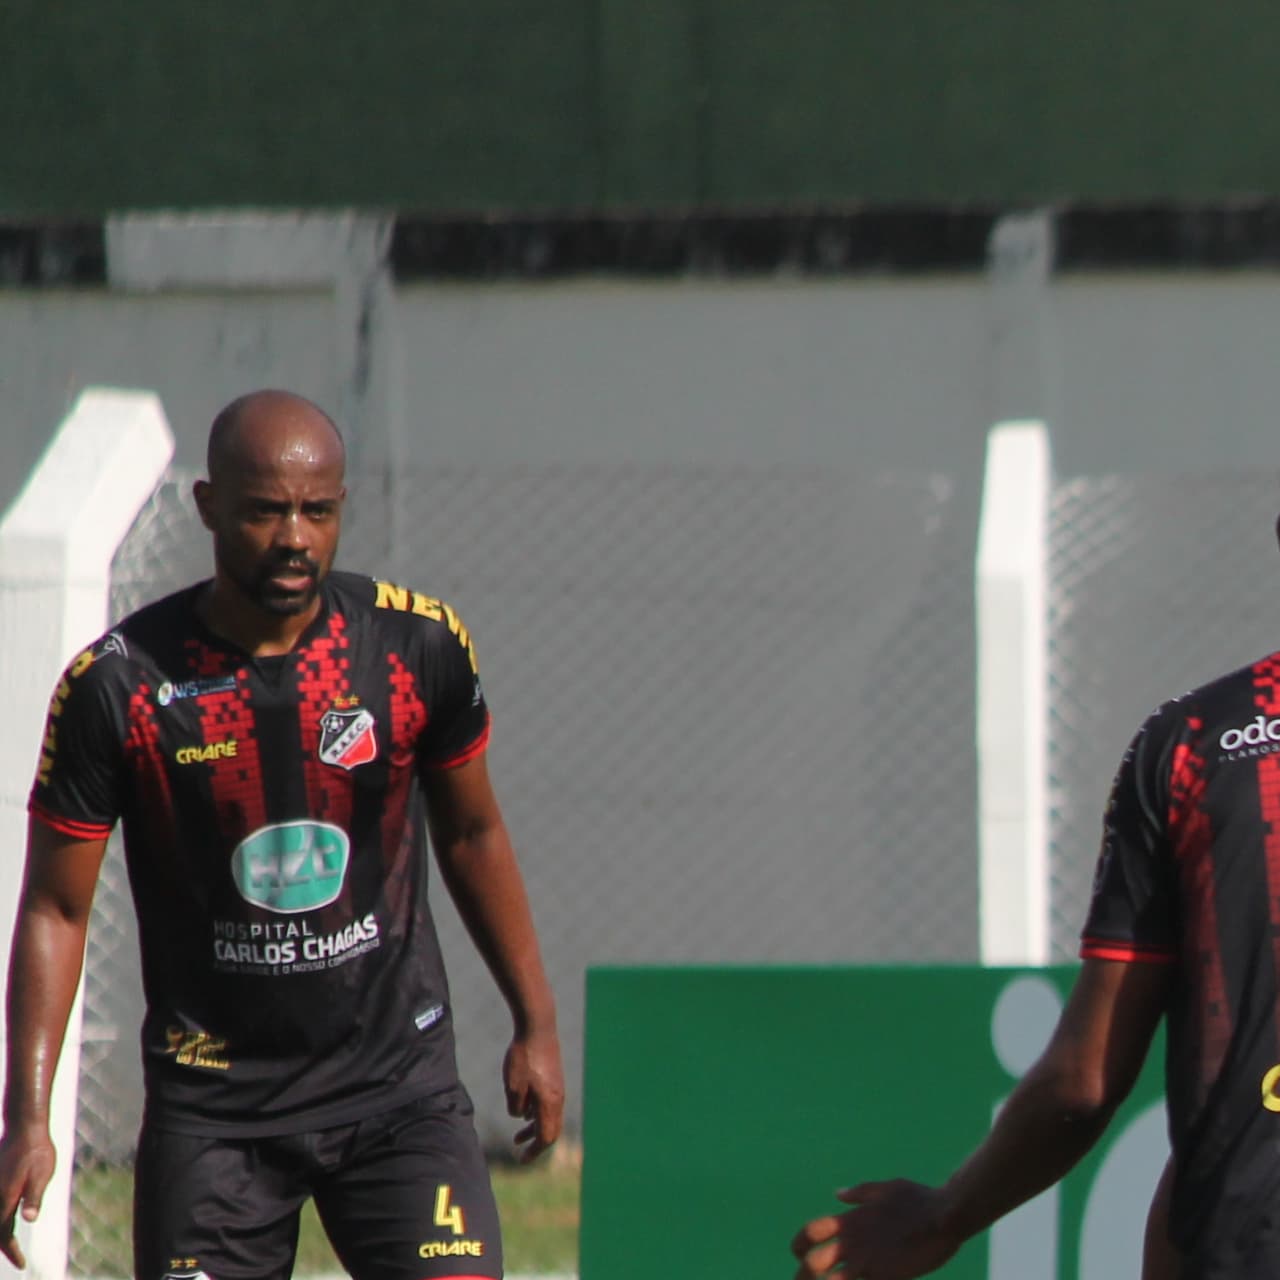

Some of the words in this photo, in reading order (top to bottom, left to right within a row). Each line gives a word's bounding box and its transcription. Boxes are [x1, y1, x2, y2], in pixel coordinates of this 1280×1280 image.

[176, 739, 238, 765] CRIARE
[213, 919, 313, 941] HOSPITAL
[213, 938, 297, 965] CARLOS
[302, 913, 379, 961] CHAGAS
[433, 1185, 466, 1236] 4
[419, 1239, 484, 1258] CRIARE
